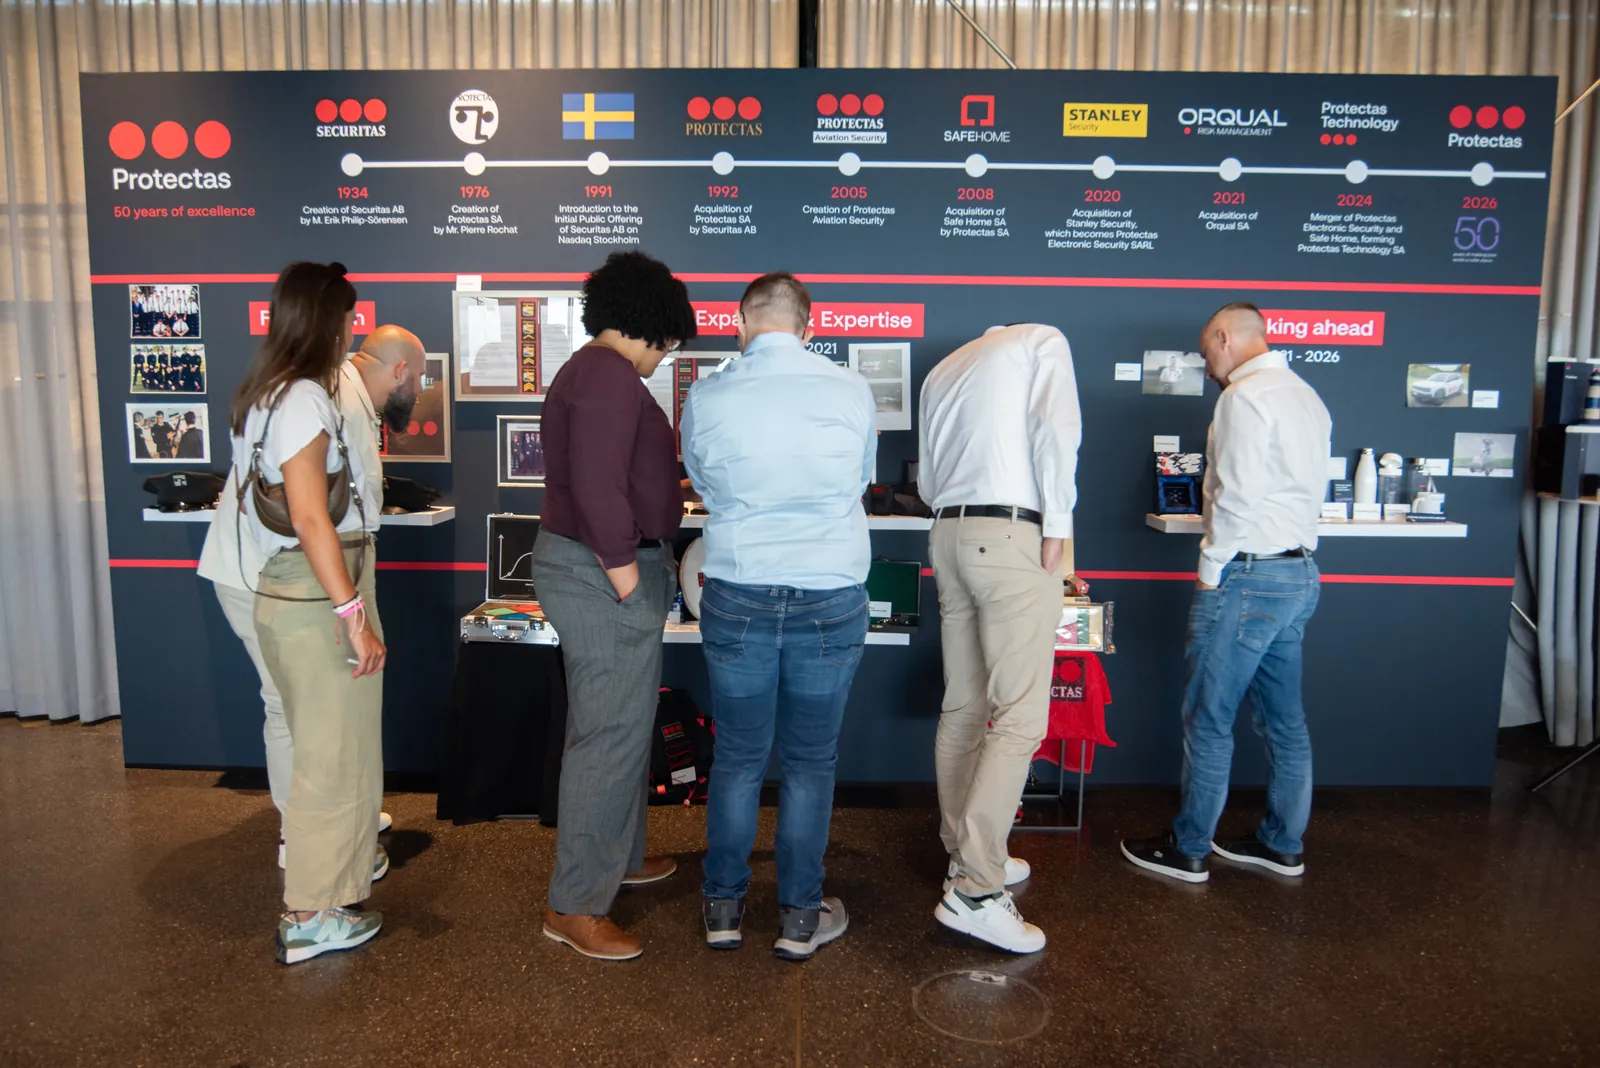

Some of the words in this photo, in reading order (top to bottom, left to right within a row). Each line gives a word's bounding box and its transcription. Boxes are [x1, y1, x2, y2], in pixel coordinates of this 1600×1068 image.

[1321, 101, 1388, 115] Protectas
[1069, 109, 1142, 122] STANLEY
[1178, 108, 1288, 127] ORQUAL
[685, 122, 763, 137] PROTECTAS
[817, 118, 884, 129] PROTECTAS
[1069, 123, 1099, 133] Security
[1321, 116, 1399, 132] Technology
[316, 125, 387, 138] SECURITAS
[944, 130, 1011, 143] SAFEHOME
[1197, 127, 1215, 136] RISK
[1216, 128, 1272, 136] MANAGEMENT
[814, 133, 849, 142] Aviation
[851, 134, 886, 144] Security
[1448, 133, 1522, 149] Protectas
[112, 168, 232, 190] Protectas
[338, 187, 369, 199] 1934
[460, 186, 490, 199] 1976
[585, 186, 612, 198] 1991
[707, 186, 739, 198] 1992
[831, 186, 868, 199] 2005
[957, 188, 994, 200] 2008
[1084, 190, 1121, 203] 2020
[1213, 192, 1245, 204] 2021
[1337, 194, 1373, 207] 2024
[1462, 197, 1497, 209] 2026
[113, 206, 131, 218] 50
[133, 207, 168, 221] years
[171, 205, 184, 217] of
[187, 205, 256, 217] excellence
[302, 206, 338, 215] Creation
[340, 206, 349, 214] of
[351, 206, 391, 215] Securitas
[392, 206, 405, 215] AB
[451, 205, 488, 214] Creation
[490, 205, 499, 214] of
[558, 205, 609, 214] Introduction
[610, 205, 622, 214] to
[623, 205, 638, 214] the
[693, 205, 742, 215] Acquisition
[743, 204, 753, 214] of
[802, 205, 840, 214] Creation
[842, 205, 851, 214] of
[853, 206, 895, 215] Protectas
[945, 207, 994, 218] Acquisition
[996, 207, 1006, 216] of
[1072, 208, 1121, 219] Acquisition
[1122, 209, 1132, 218] of
[300, 216, 311, 226] by
[312, 216, 323, 225] M.
[324, 216, 340, 225] Erik
[341, 216, 408, 226] Philip-Sörensen
[448, 215, 489, 224] Protectas
[490, 215, 503, 224] SA
[555, 215, 578, 224] Initial
[579, 215, 606, 224] Public
[607, 214, 643, 225] Offering
[695, 215, 737, 224] Protectas
[739, 215, 751, 224] SA
[812, 216, 847, 225] Aviation
[849, 216, 885, 226] Security
[943, 217, 964, 226] Safe
[966, 218, 992, 226] Home
[994, 218, 1007, 227] SA
[1198, 210, 1246, 222] Acquisition
[1248, 211, 1258, 220] of
[1310, 213, 1342, 224] Merger
[1344, 213, 1353, 222] of
[1355, 214, 1397, 223] Protectas
[433, 225, 444, 236] by
[445, 226, 459, 234] Mr.
[461, 226, 485, 234] Pierre
[487, 226, 518, 234] Rochat
[559, 225, 568, 234] of
[570, 225, 610, 234] Securitas
[612, 225, 625, 234] AB
[689, 225, 700, 236] by
[701, 226, 743, 234] Securitas
[744, 226, 757, 235] AB
[1066, 219, 1098, 230] Stanley
[1100, 219, 1138, 230] Security,
[1205, 221, 1236, 231] Orqual
[1237, 222, 1250, 231] SA
[1303, 223, 1347, 233] Electronic
[1348, 224, 1383, 235] Security
[1385, 224, 1403, 234] and
[940, 227, 952, 238] by
[953, 228, 995, 237] Protectas
[997, 229, 1010, 237] SA
[1045, 229, 1071, 238] which
[1072, 230, 1114, 239] becomes
[1116, 230, 1158, 239] Protectas
[1454, 215, 1500, 251] 50
[558, 235, 592, 246] Nasdaq
[593, 235, 640, 245] Stockholm
[1048, 240, 1092, 249] Electronic
[1093, 240, 1129, 251] Security
[1131, 241, 1154, 250] SARL
[1309, 234, 1329, 243] Safe
[1331, 234, 1359, 244] Home,
[1361, 235, 1395, 246] forming
[1297, 244, 1340, 254] Protectas
[1341, 244, 1391, 256] Technology
[1393, 245, 1405, 255] SA
[695, 309, 740, 330] Expa
[821, 310, 913, 331] Expertise
[1266, 317, 1309, 339] king
[1312, 319, 1374, 337] ahead
[1304, 350, 1341, 363] 2026
[1050, 686, 1083, 698] CTAS
